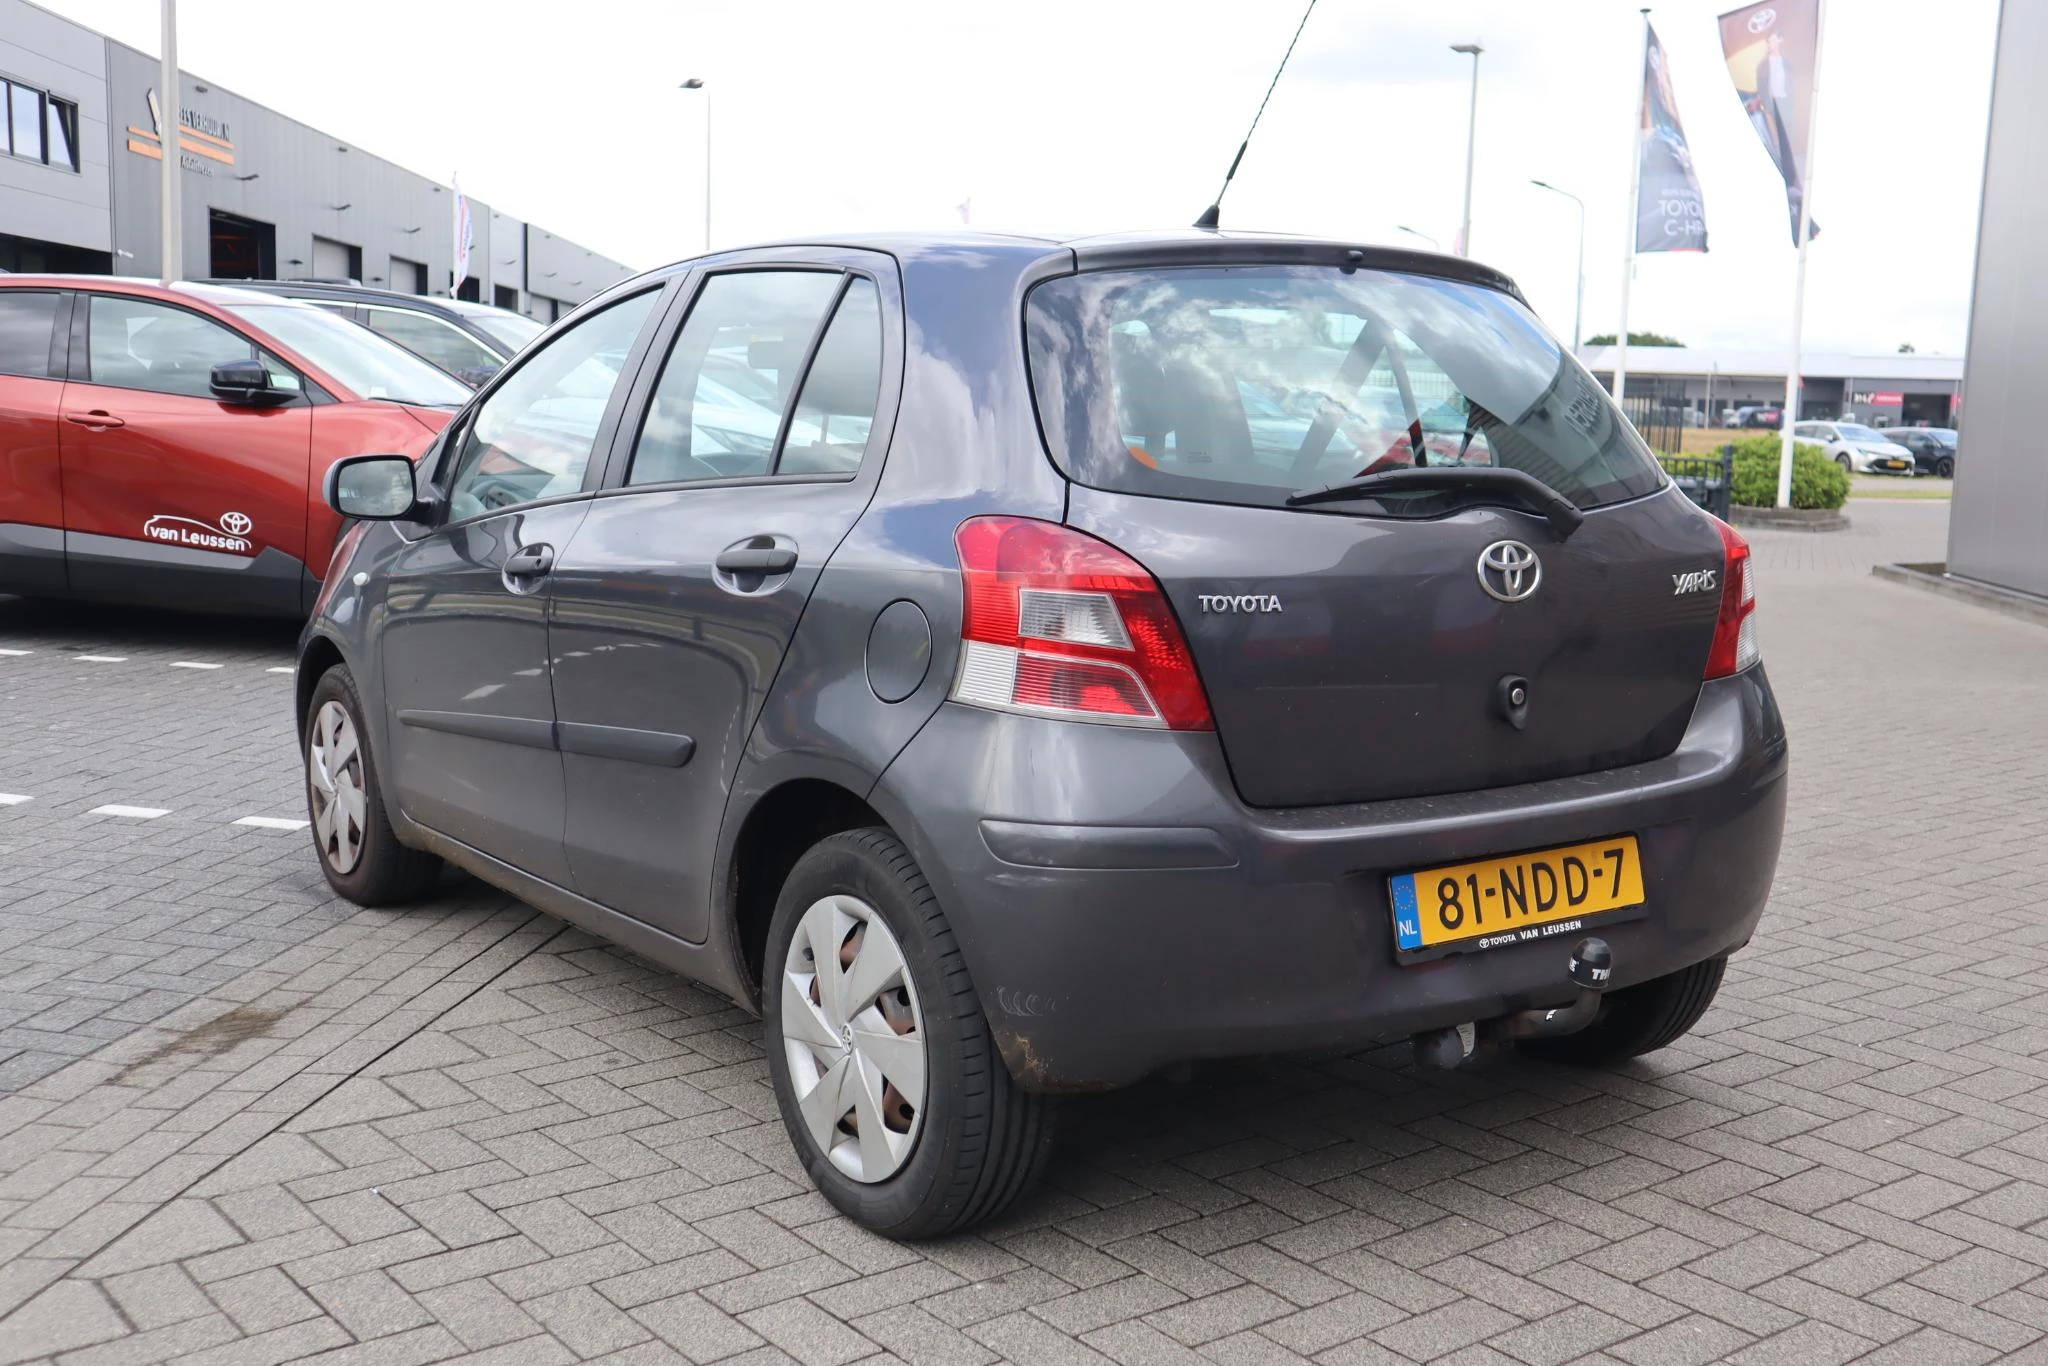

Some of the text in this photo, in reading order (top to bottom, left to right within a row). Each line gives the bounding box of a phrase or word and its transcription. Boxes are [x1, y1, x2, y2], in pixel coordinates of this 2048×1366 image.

[150, 526, 245, 552] van Leussen
[1198, 594, 1283, 613] TOYOTA
[1437, 848, 1624, 930] 81-NDD-7
[1399, 919, 1418, 937] NL
[1489, 920, 1582, 946] TOYOTA VAN LEUSSEN
